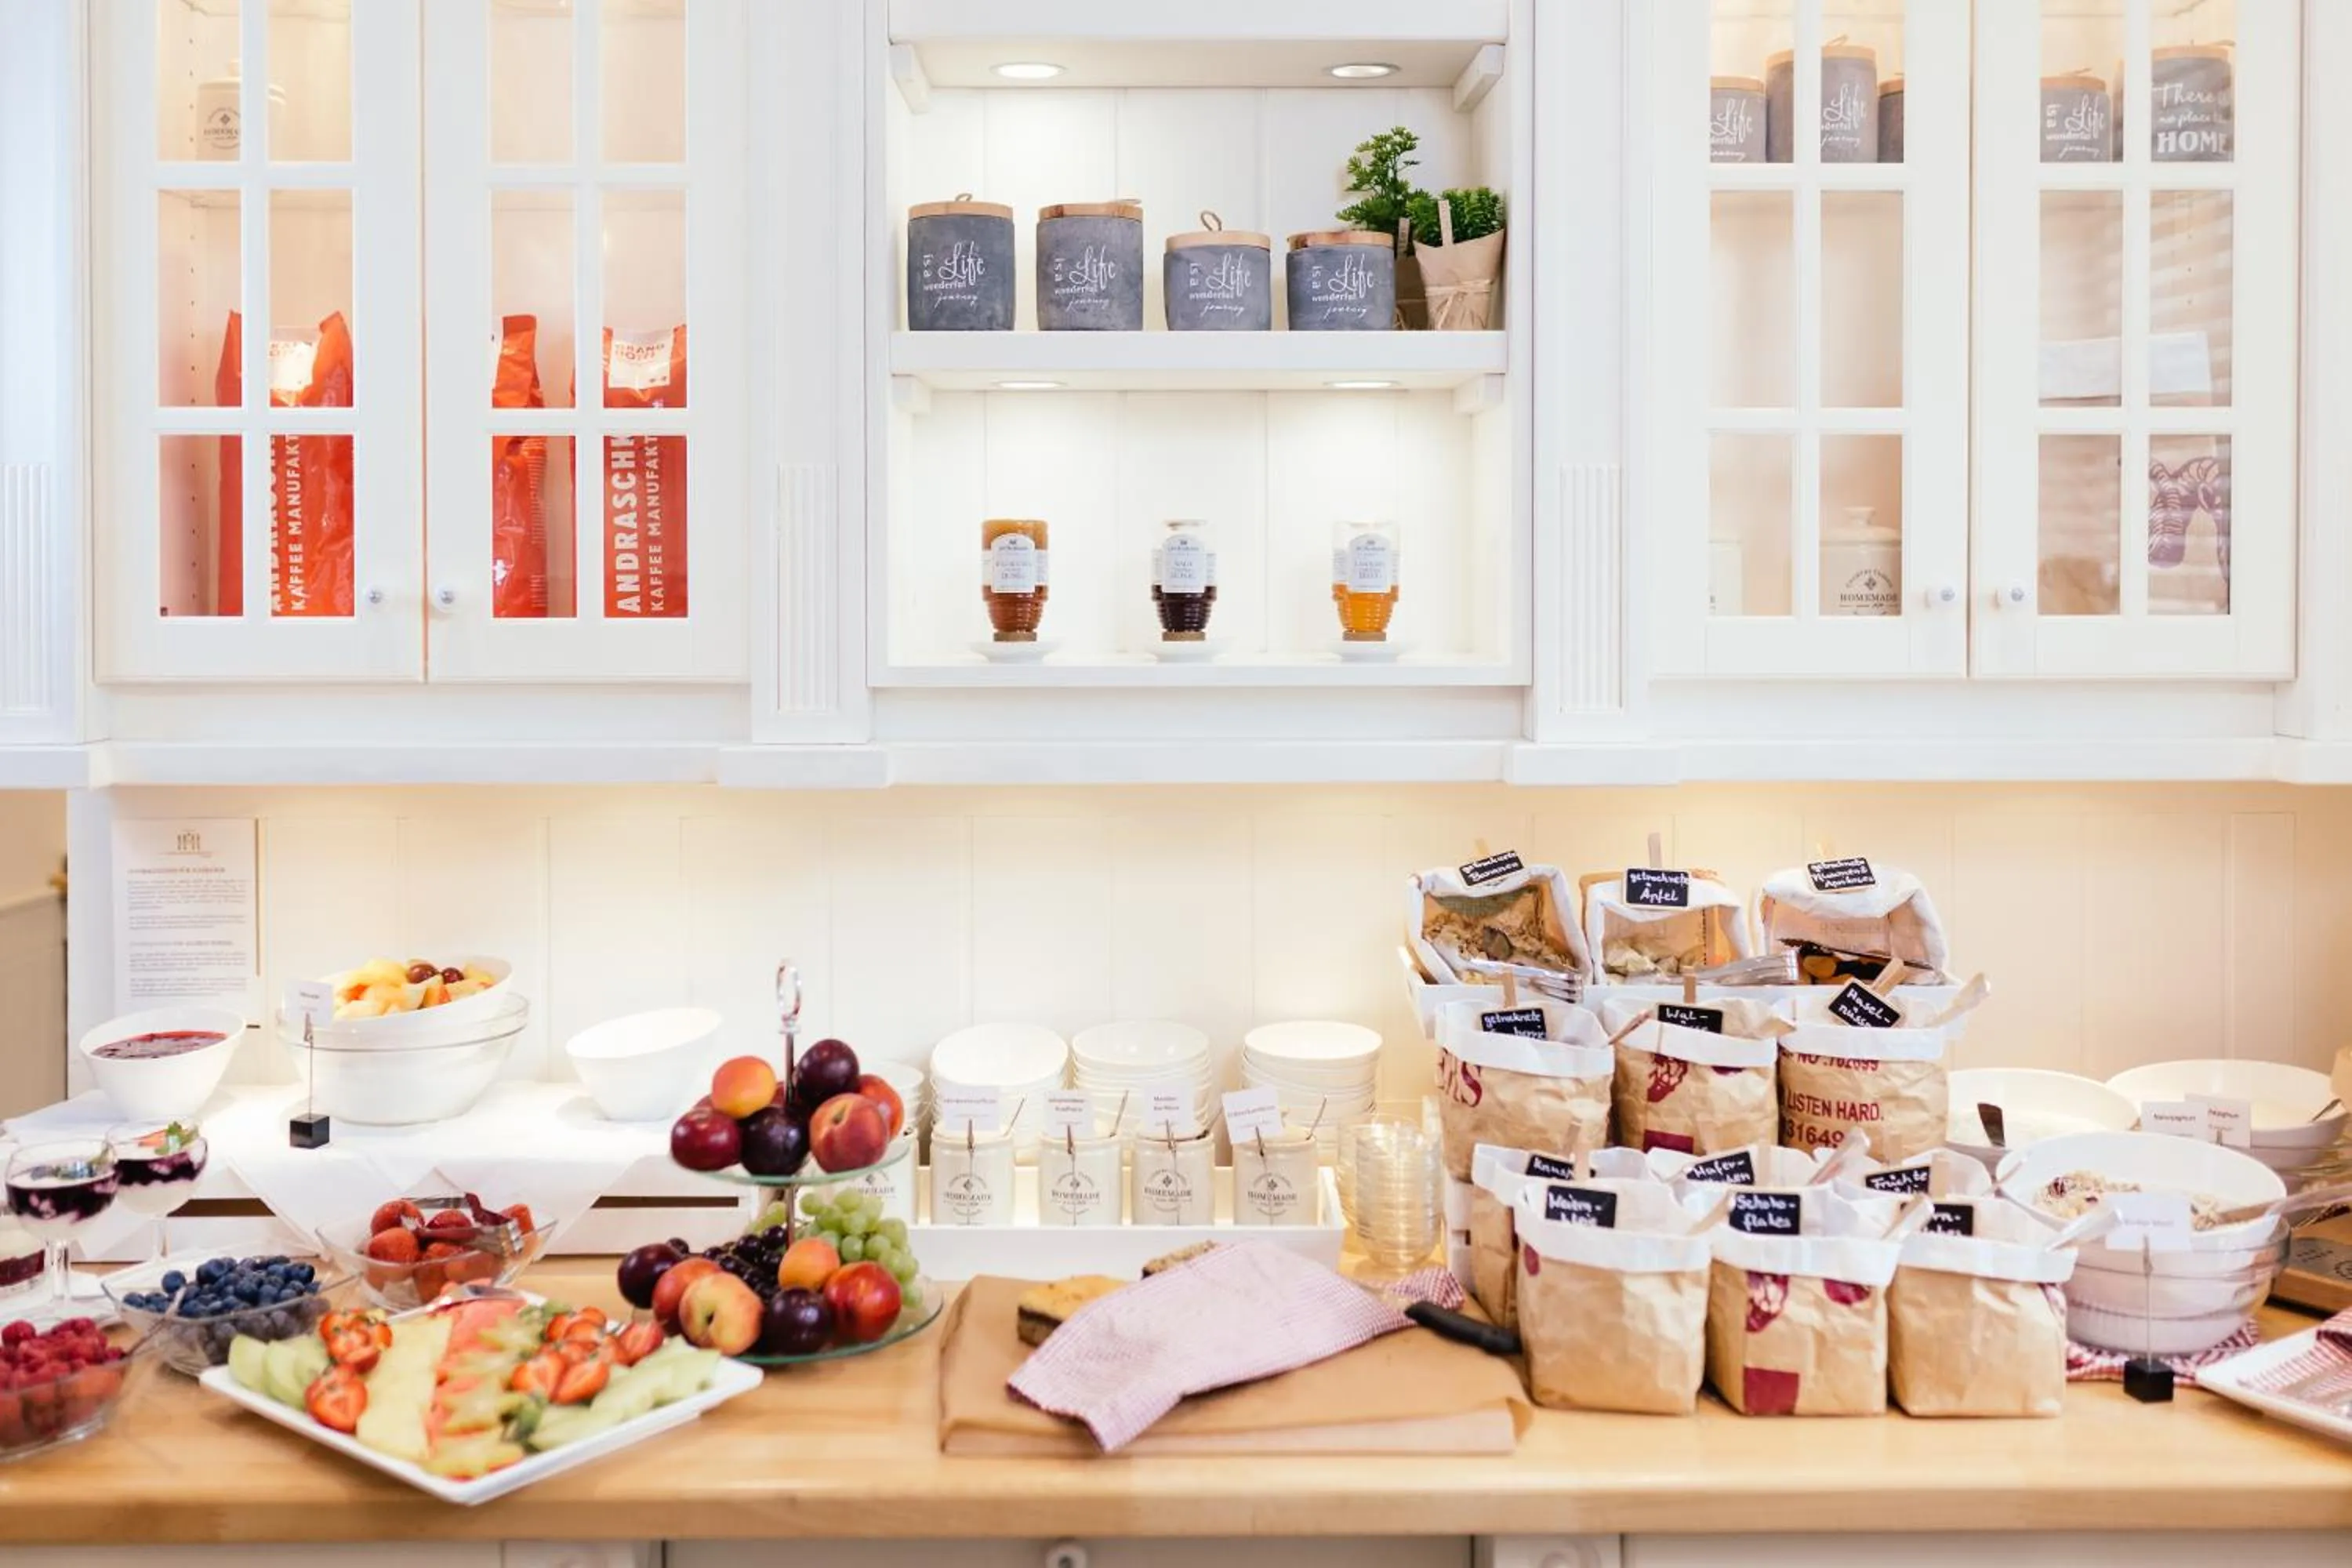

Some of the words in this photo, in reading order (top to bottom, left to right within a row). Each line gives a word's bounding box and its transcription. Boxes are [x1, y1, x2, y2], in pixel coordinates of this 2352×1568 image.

[2152, 82, 2214, 108] There
[938, 241, 985, 286] Life
[1069, 245, 1116, 290] Life
[1205, 252, 1252, 297] Life
[1327, 253, 1374, 299] Life
[288, 543, 307, 612] KAFFEE
[648, 544, 665, 612] KAFFEE
[1787, 1088, 1832, 1118] LISTEN
